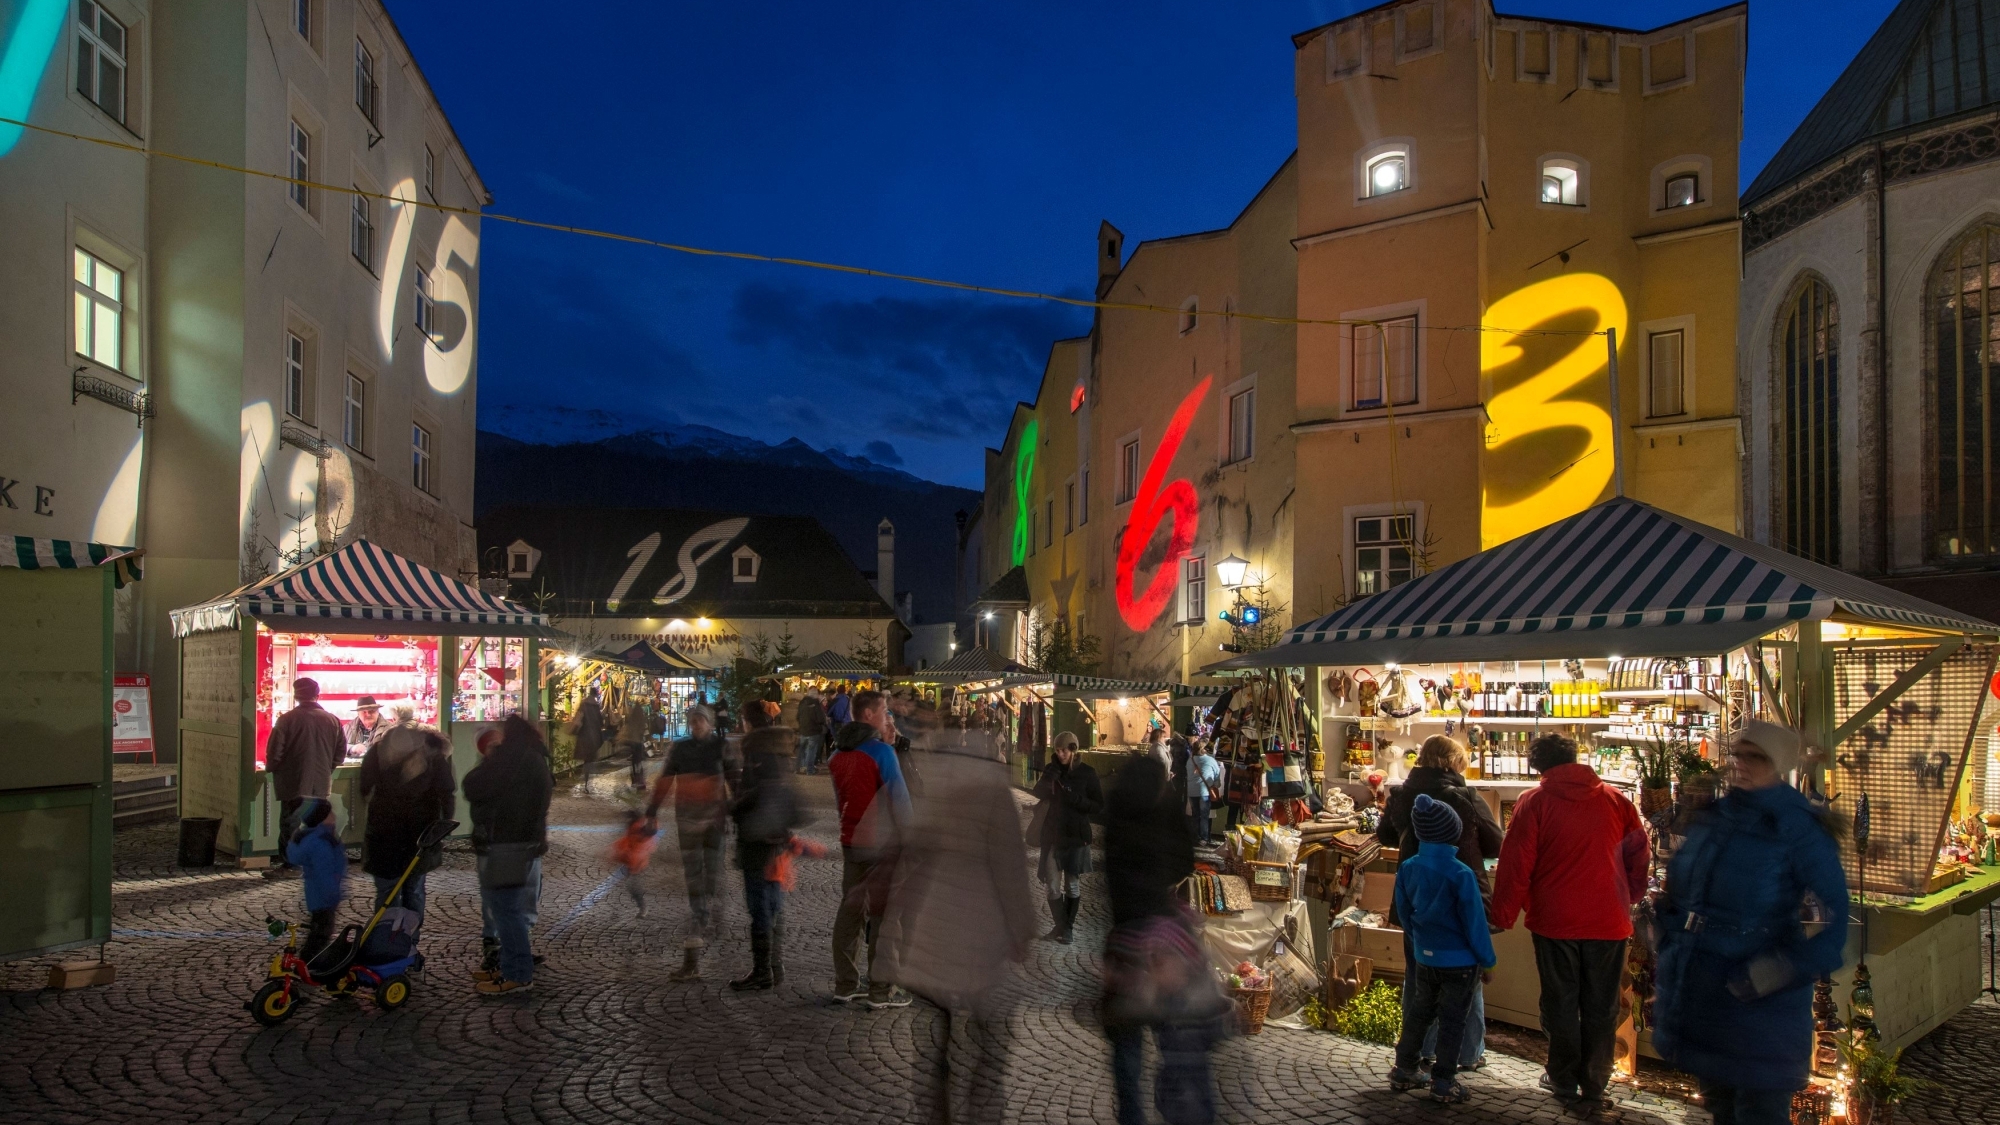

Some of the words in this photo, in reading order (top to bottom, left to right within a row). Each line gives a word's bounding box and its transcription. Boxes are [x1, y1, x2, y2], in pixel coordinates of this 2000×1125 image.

[379, 177, 479, 394] 15
[1012, 418, 1039, 567] 8
[1115, 373, 1213, 633] 6
[1480, 272, 1628, 552] 3
[606, 517, 750, 612] 18
[610, 632, 739, 645] EISENWARENHANDLUNG
